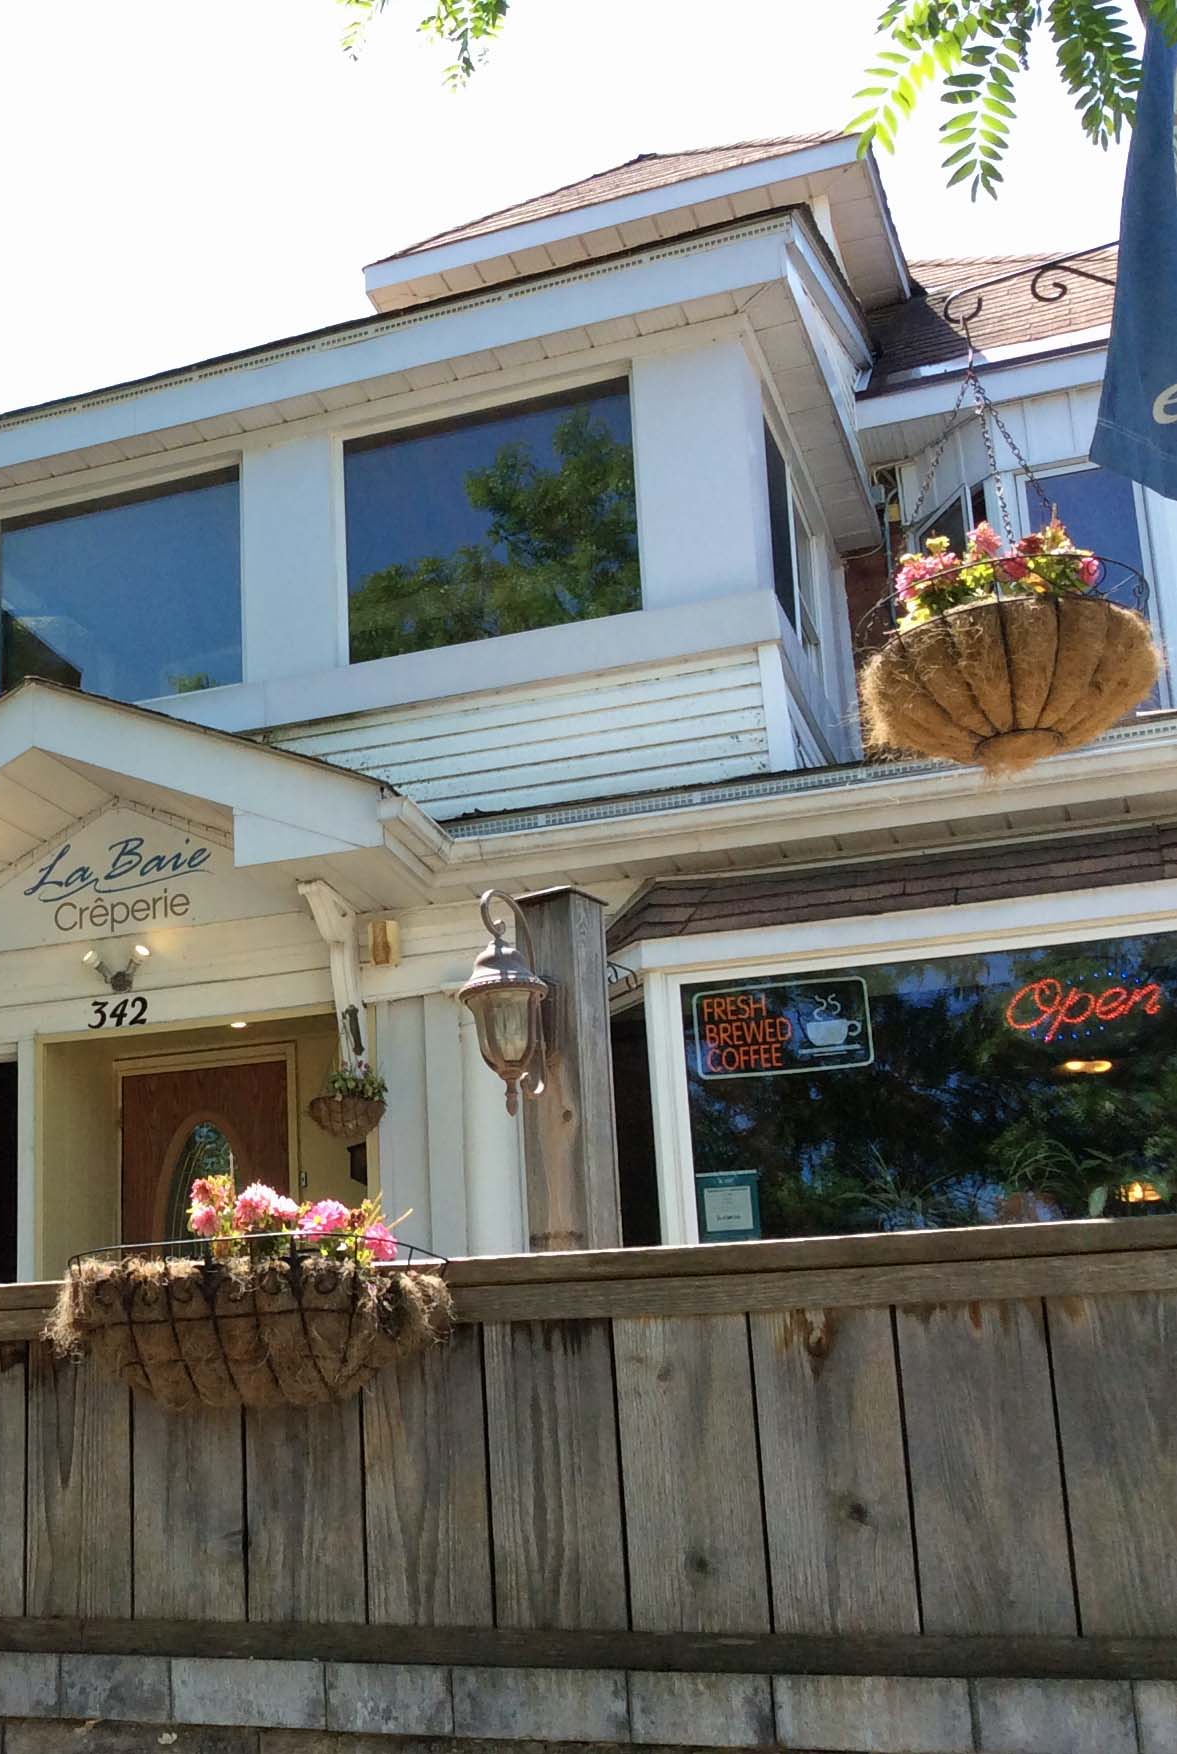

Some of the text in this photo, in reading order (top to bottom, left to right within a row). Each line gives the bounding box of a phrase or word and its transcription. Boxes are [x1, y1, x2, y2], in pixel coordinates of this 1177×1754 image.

[24, 837, 212, 896] La Baie
[53, 887, 191, 933] Crêperie
[87, 996, 149, 1029] 342
[702, 992, 768, 1022] FRESH
[1005, 977, 1162, 1044] Open
[704, 1016, 793, 1048] BREWED
[706, 1043, 785, 1073] COFFEE
